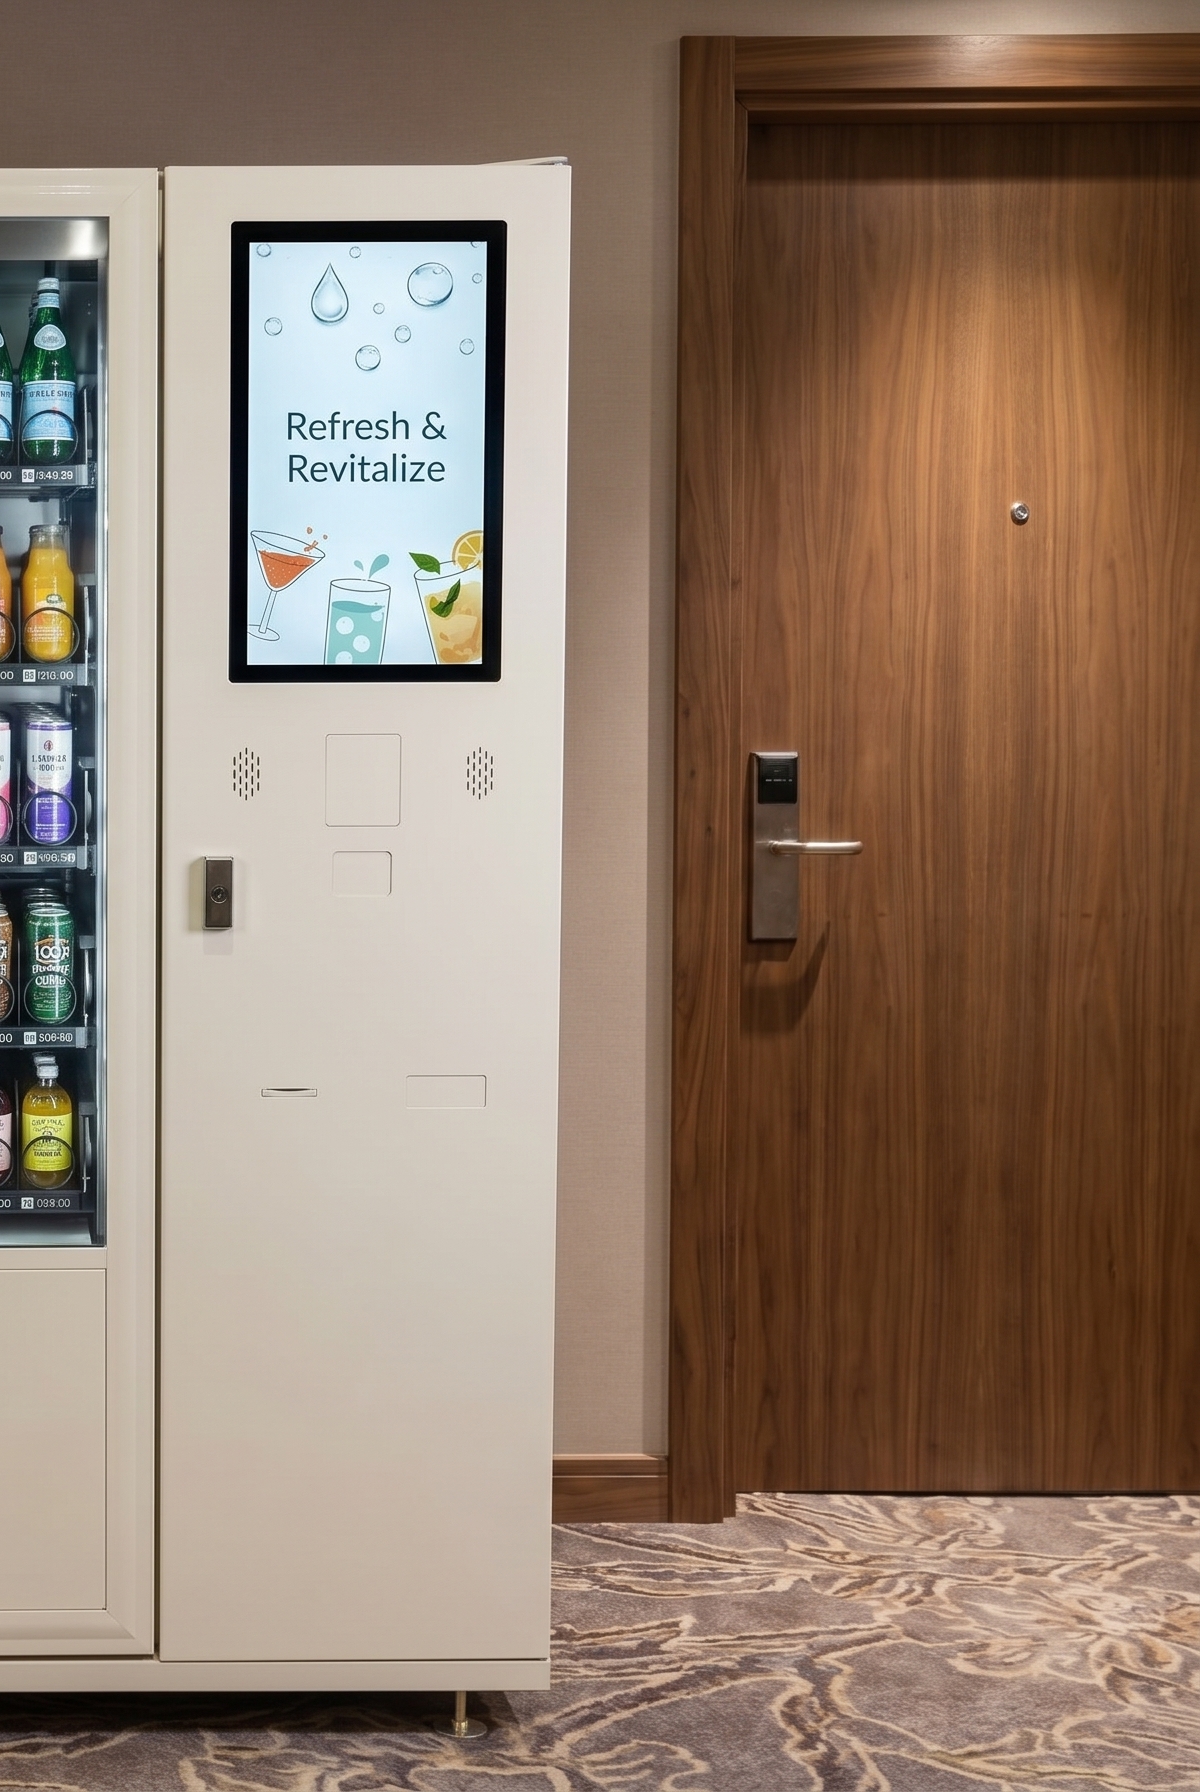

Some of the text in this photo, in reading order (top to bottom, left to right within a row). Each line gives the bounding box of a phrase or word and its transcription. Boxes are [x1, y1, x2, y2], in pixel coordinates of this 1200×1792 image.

[287, 411, 448, 441] Refresh &
[288, 454, 446, 483] Revitalize
